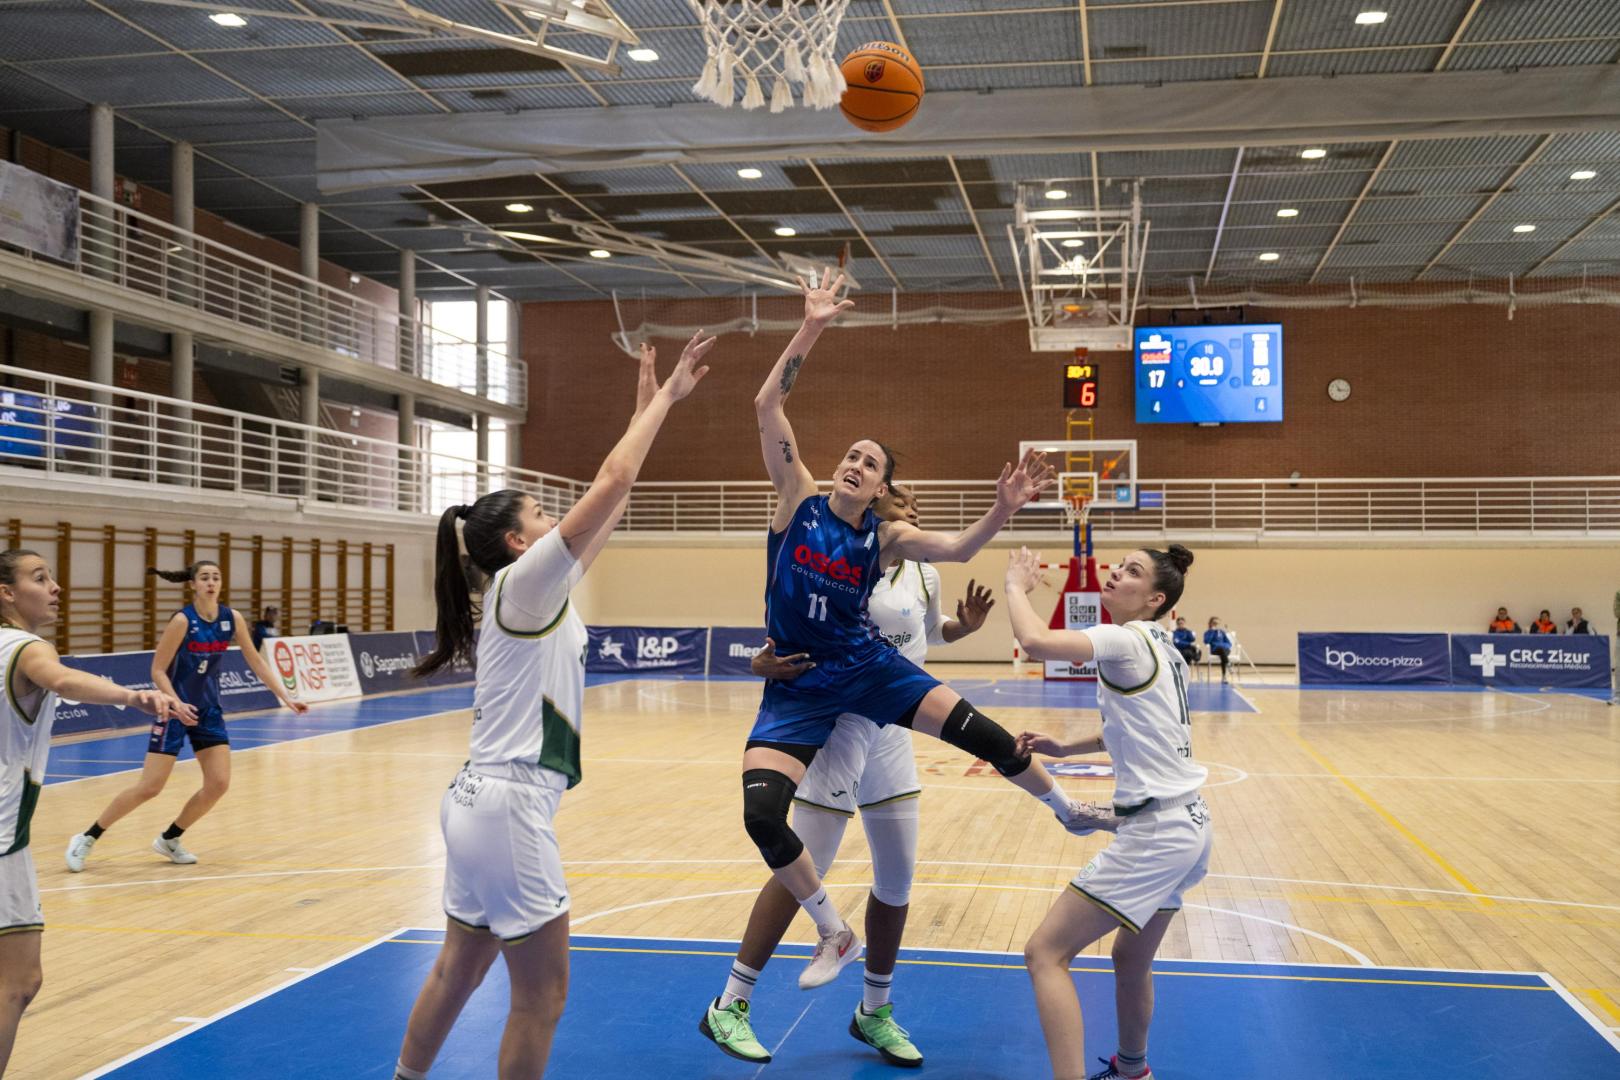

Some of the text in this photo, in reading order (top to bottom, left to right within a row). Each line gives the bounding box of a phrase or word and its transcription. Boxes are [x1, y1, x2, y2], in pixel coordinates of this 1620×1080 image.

[1148, 369, 1166, 388] 17
[1081, 383, 1095, 406] 6
[1257, 399, 1264, 411] 4
[1153, 401, 1161, 413] 4
[808, 593, 828, 621] 11
[293, 643, 323, 664] FNB
[637, 636, 678, 658] I&P
[1510, 649, 1590, 663] CRC Zizur
[197, 660, 208, 674] 9
[1325, 646, 1423, 670] bp boca-pizza
[299, 667, 327, 690] NSF
